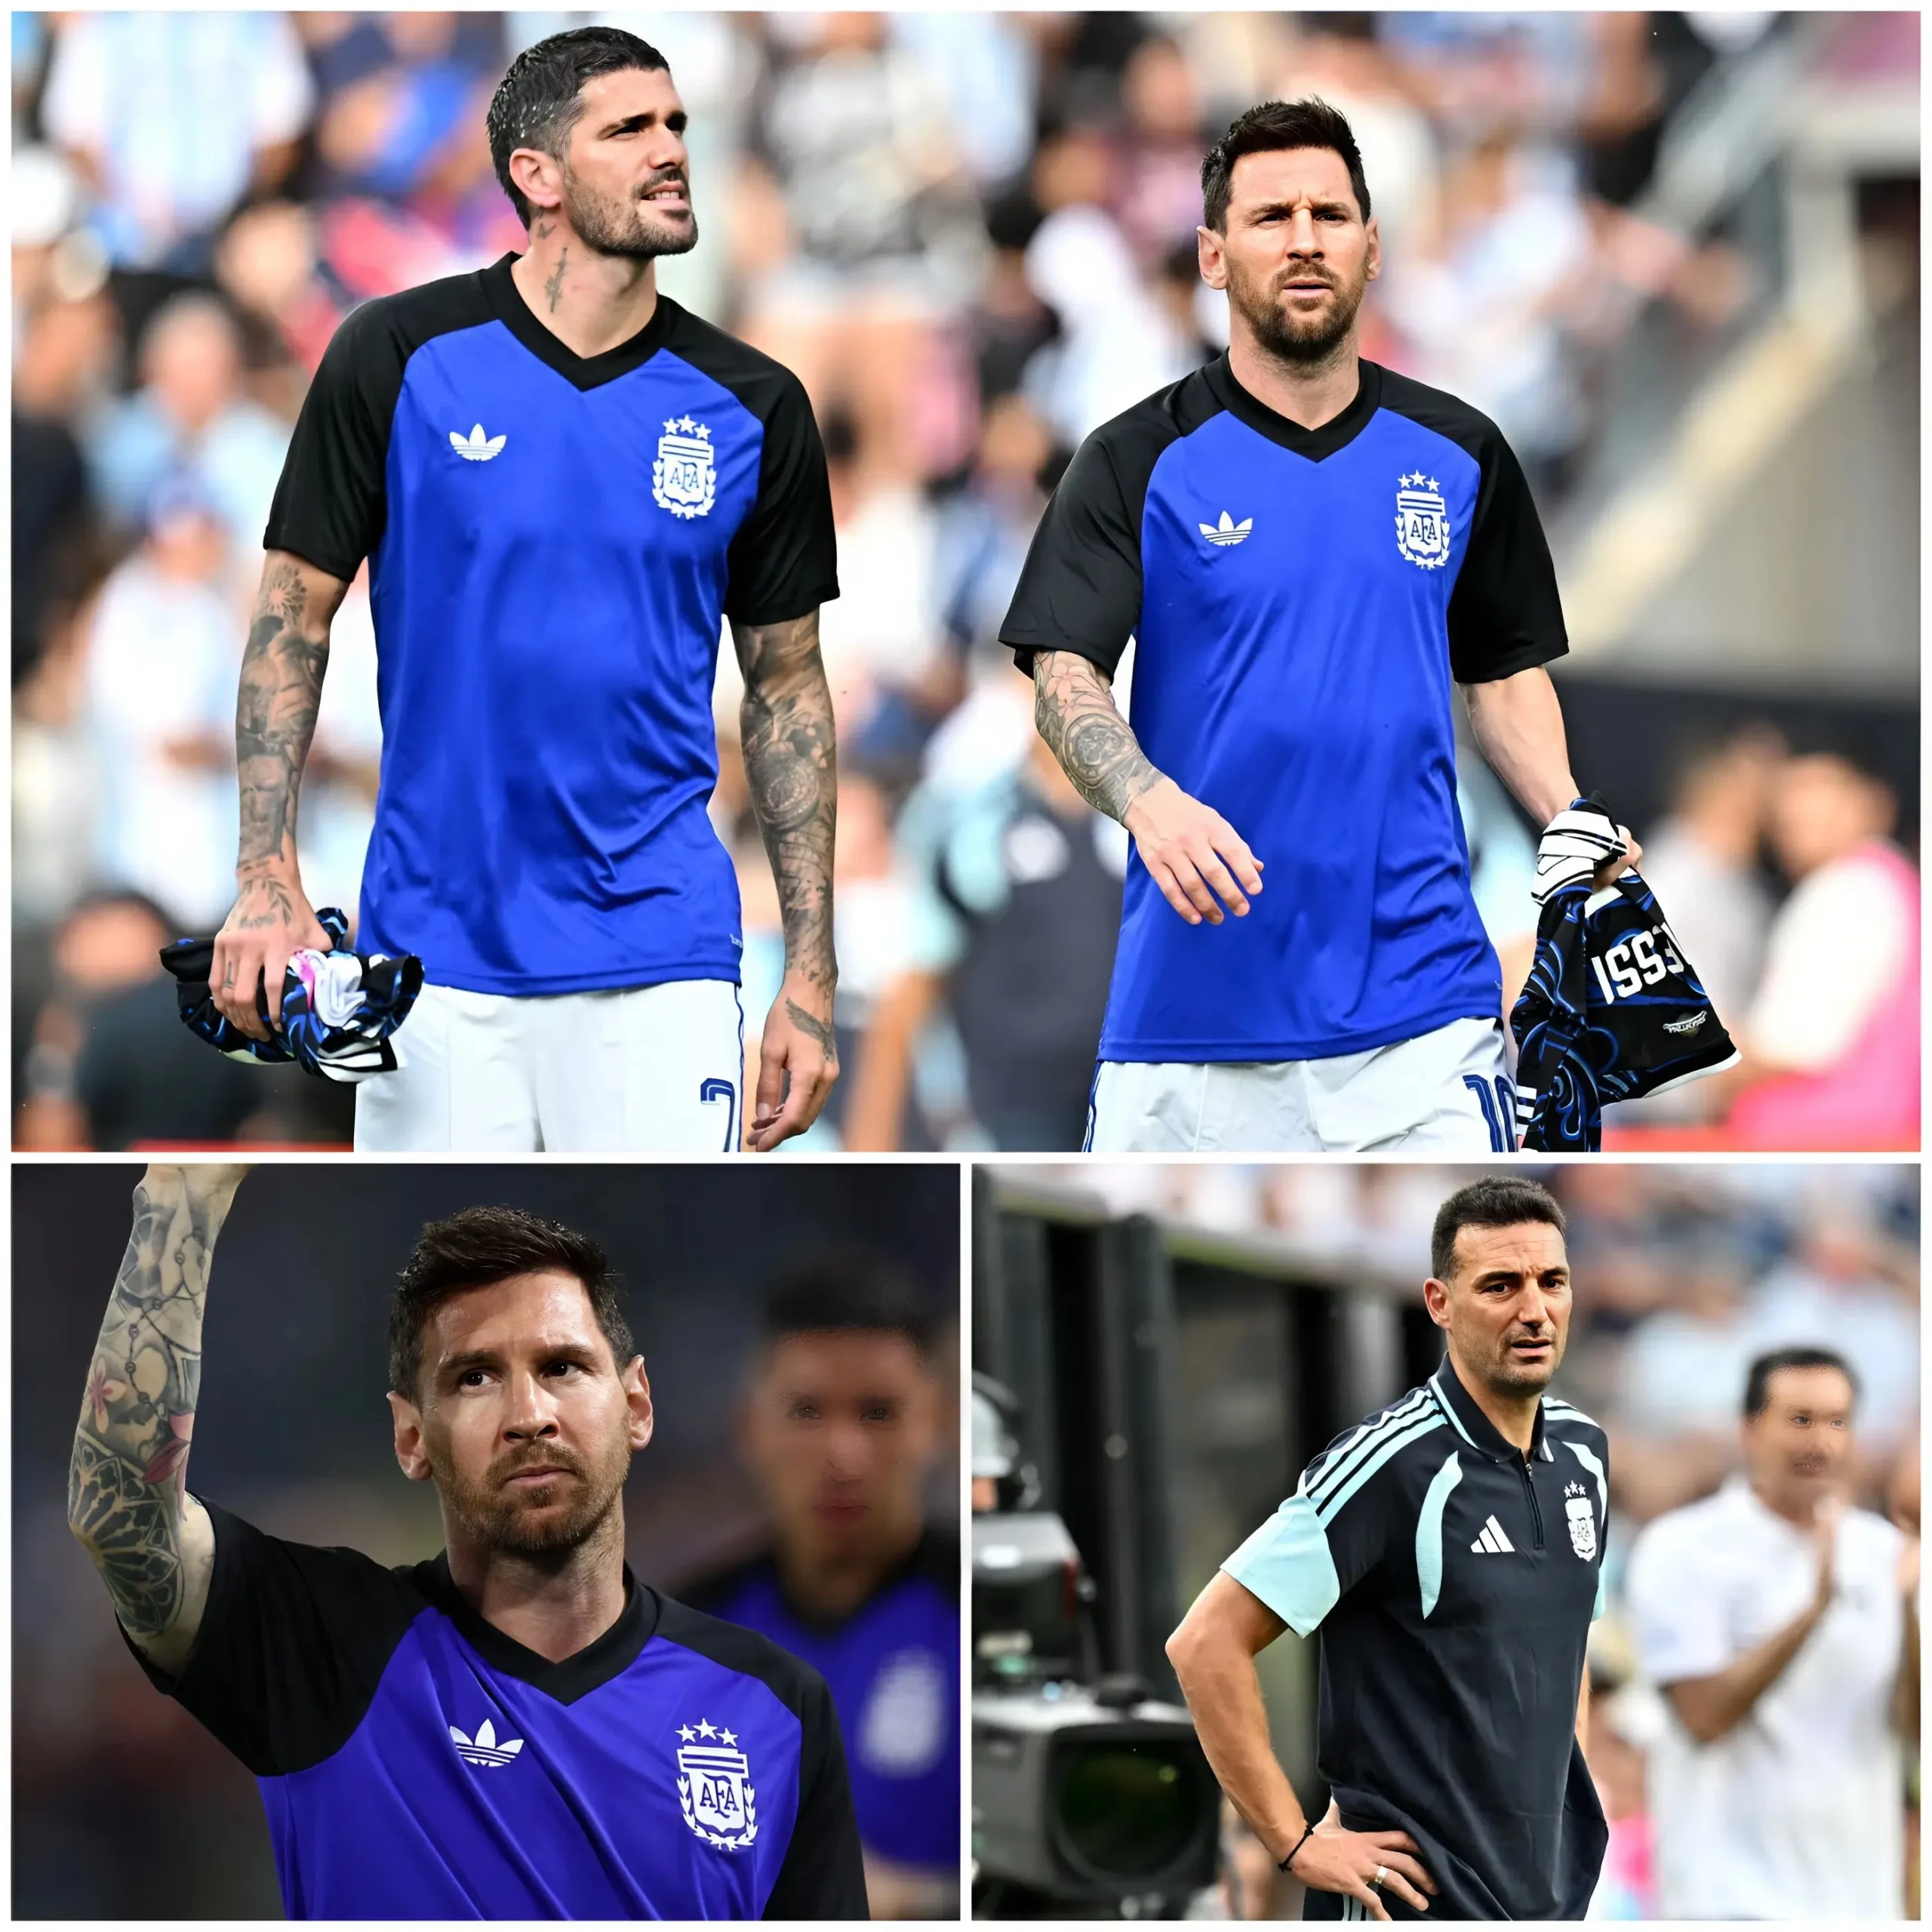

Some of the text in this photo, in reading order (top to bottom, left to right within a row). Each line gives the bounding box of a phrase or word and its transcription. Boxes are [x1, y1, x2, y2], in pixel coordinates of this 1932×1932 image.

[669, 460, 700, 493] AFA
[1410, 512, 1438, 546] AFA
[1590, 921, 1686, 1005] ESSI
[699, 1772, 740, 1819] AFA
